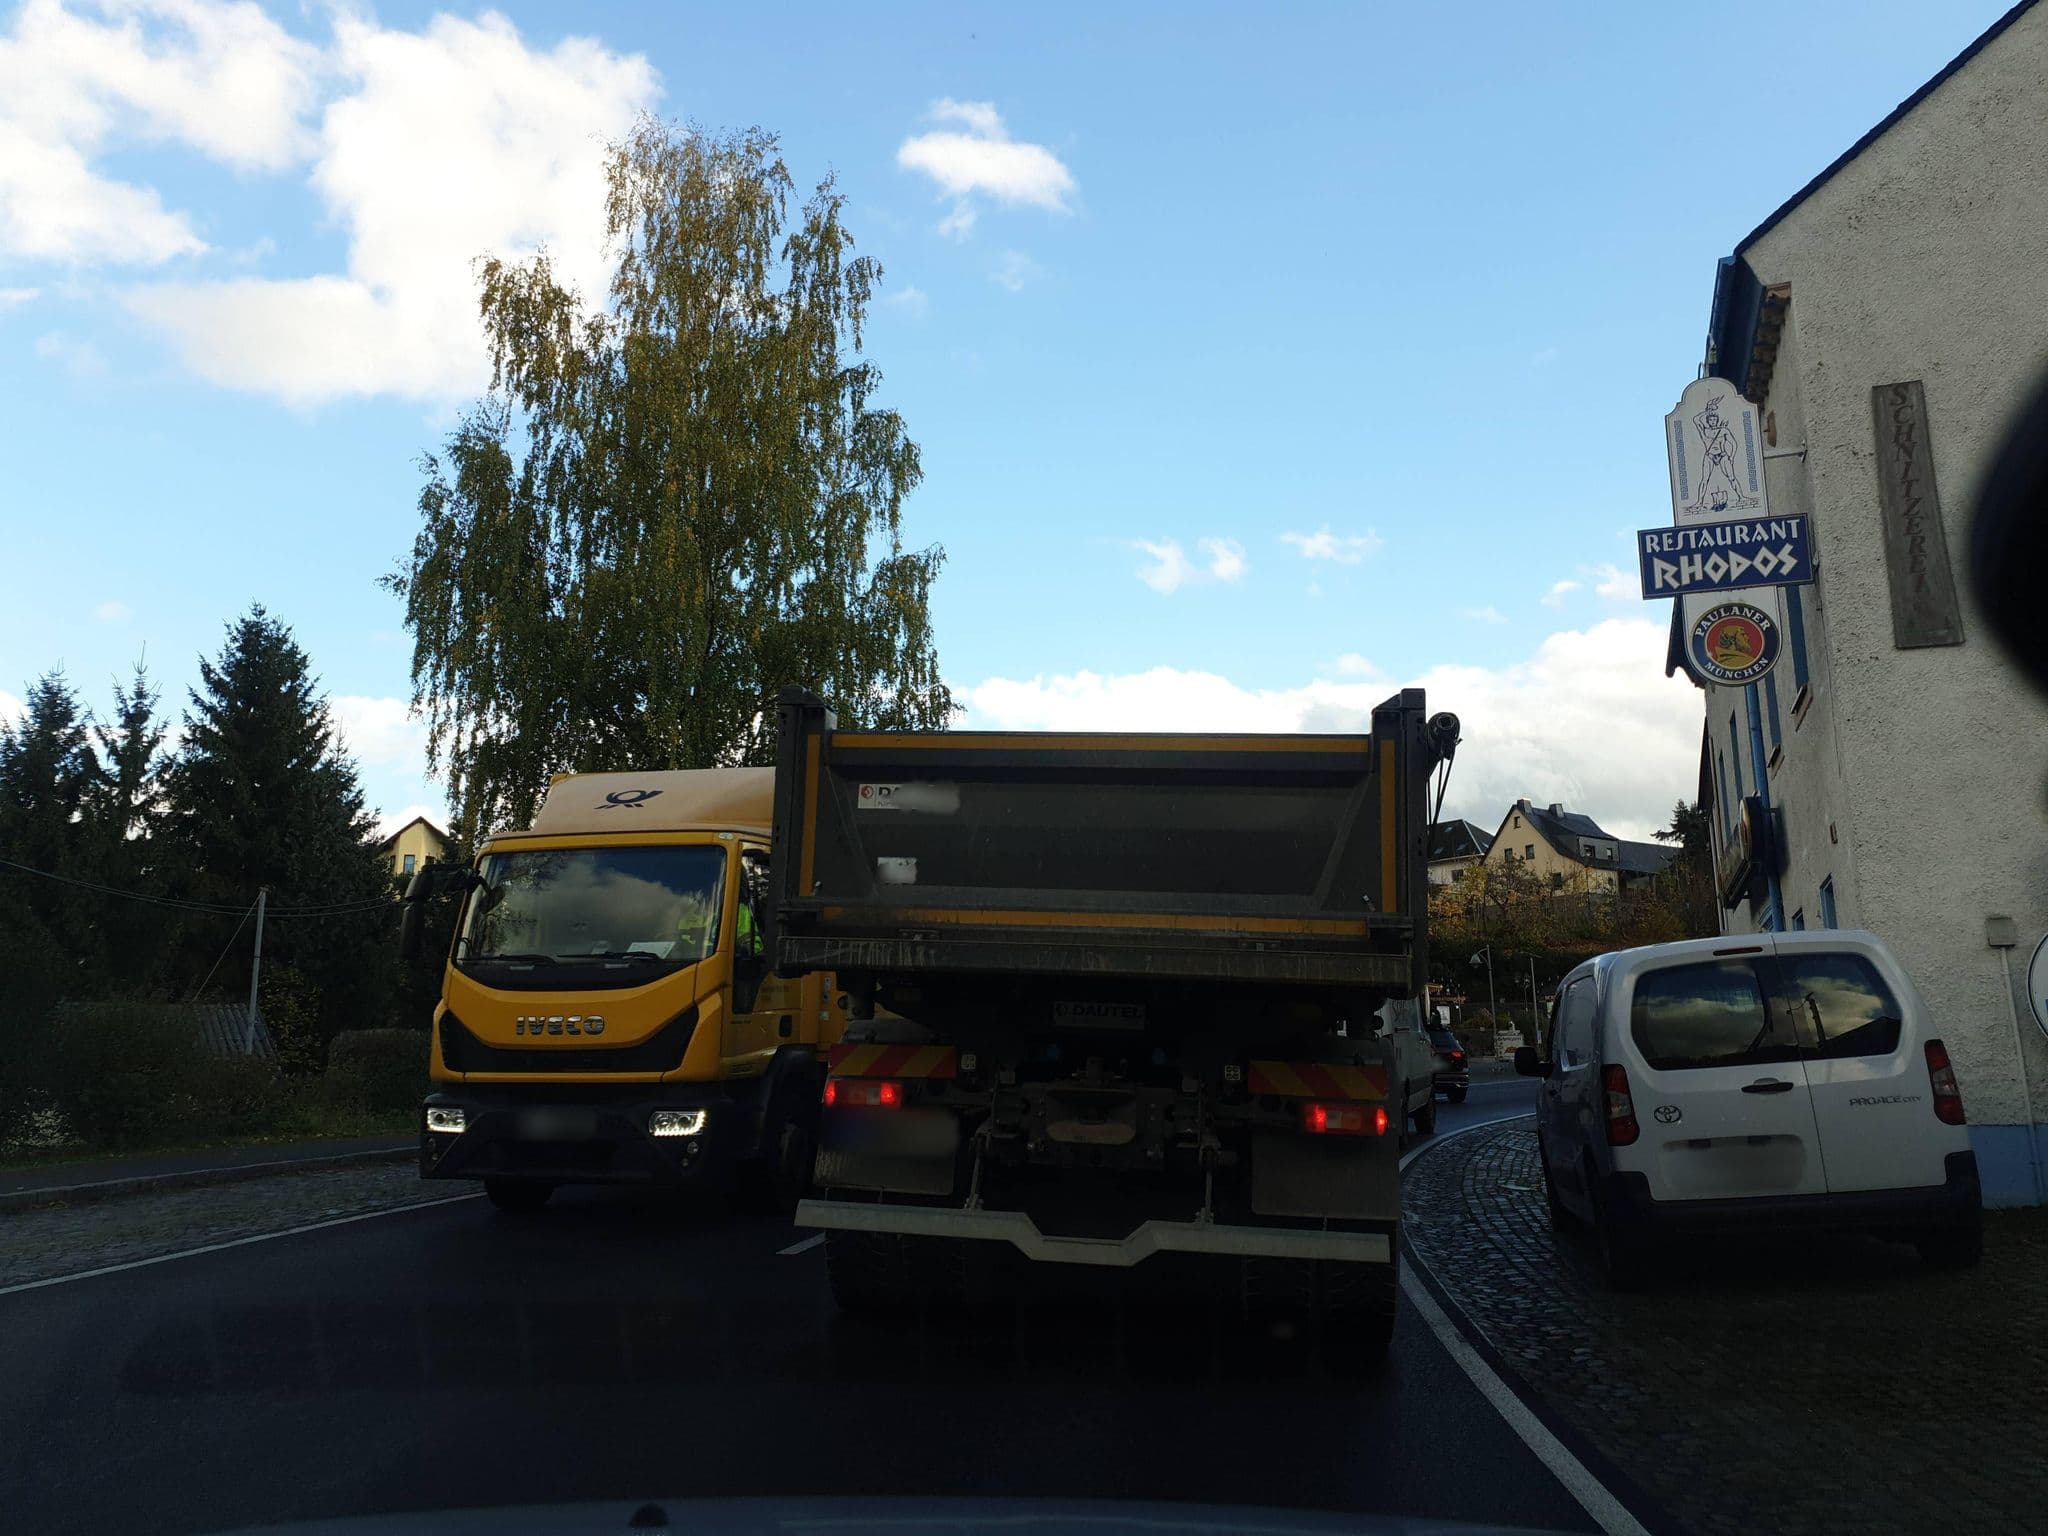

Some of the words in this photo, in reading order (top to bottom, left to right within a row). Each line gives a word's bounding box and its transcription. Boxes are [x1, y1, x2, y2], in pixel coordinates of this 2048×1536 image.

[1890, 384, 1928, 592] SCHNITZEREI
[1645, 519, 1801, 553] RESTAURANT
[1653, 543, 1799, 590] RHODOS
[1695, 606, 1772, 637] PAULANER
[515, 1014, 605, 1036] IVECO
[1073, 1006, 1143, 1018] DAUTEL
[1849, 1096, 1901, 1107] PROACE
